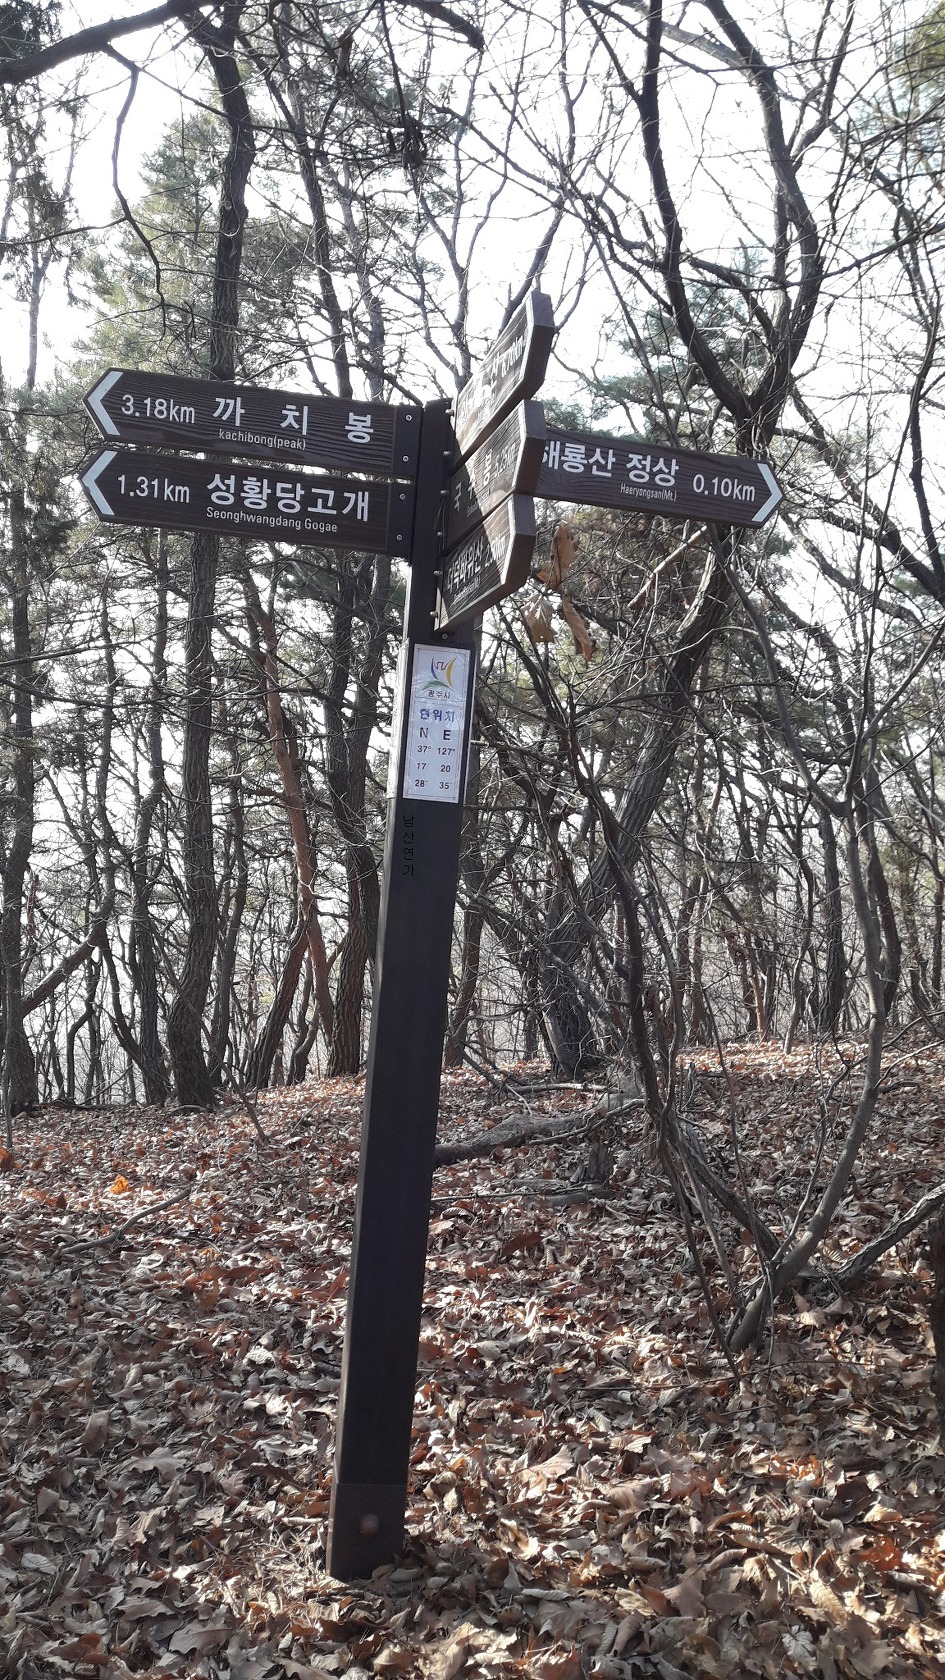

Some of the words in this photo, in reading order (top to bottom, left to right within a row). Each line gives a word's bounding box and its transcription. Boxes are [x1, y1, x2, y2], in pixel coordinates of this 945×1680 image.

[121, 394, 195, 424] 3.18km
[626, 453, 679, 487] 정상
[692, 474, 756, 502] 0.10km
[117, 474, 190, 503] 1.31km
[206, 473, 369, 521] 성황당고개
[206, 506, 301, 531] Seonghwangdang
[304, 518, 337, 533] Gogae
[428, 690, 451, 699] 광주시
[420, 708, 455, 722] 현위치
[419, 727, 429, 739] N
[443, 730, 452, 740] E
